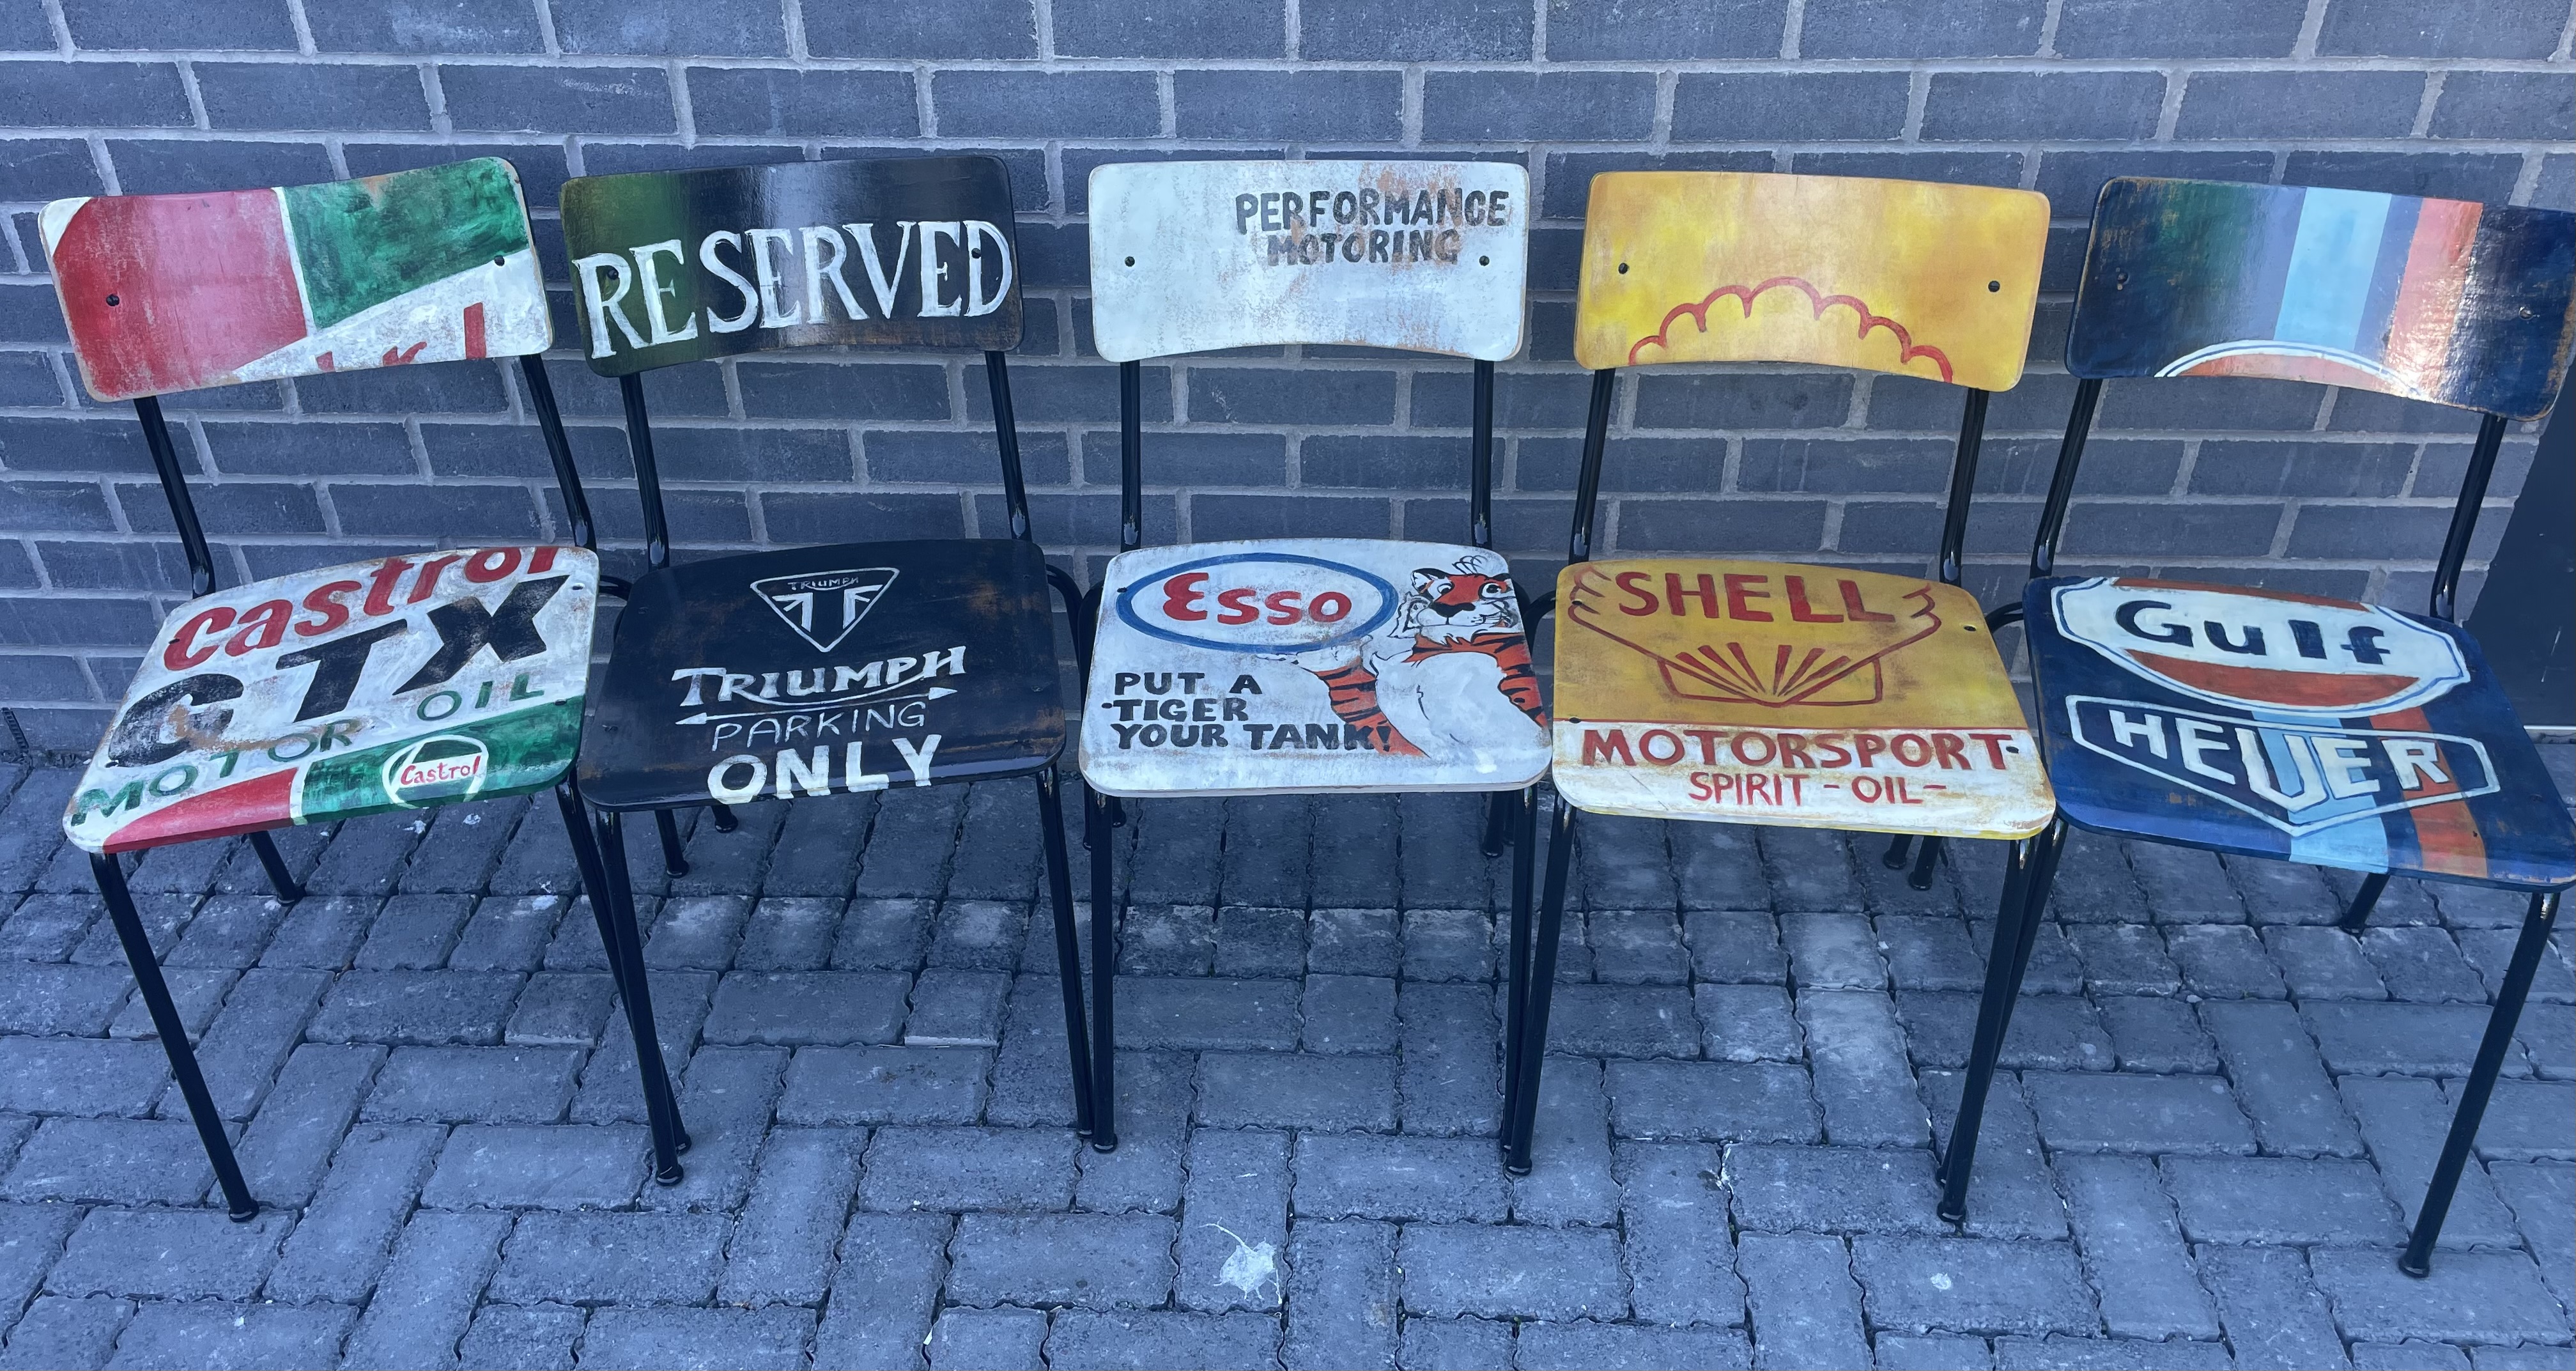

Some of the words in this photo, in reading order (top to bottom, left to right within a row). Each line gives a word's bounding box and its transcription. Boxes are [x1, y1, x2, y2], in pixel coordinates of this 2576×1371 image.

[1235, 187, 1509, 235] PERFORMANCE
[1267, 228, 1460, 267] MOTORING
[571, 220, 1014, 359] RESERVED
[786, 577, 860, 591] TRIUMPH
[1614, 571, 1896, 623] SHELL
[2114, 600, 2391, 666] Gulf
[671, 646, 967, 707] TRIUMPH
[1114, 672, 1205, 696] PUT
[1230, 674, 1262, 695] A
[711, 701, 927, 752] PARKING
[1112, 697, 1249, 722] TIGER
[70, 720, 363, 826] MOTOR
[416, 674, 546, 722] OIL
[1111, 724, 1229, 750] YOUR
[1582, 729, 2014, 771] MOTORSPORT
[399, 754, 482, 787] Castrol
[707, 734, 942, 805] ONLY
[2109, 710, 2450, 815] HEUER
[1688, 771, 1803, 807] SPIRIT
